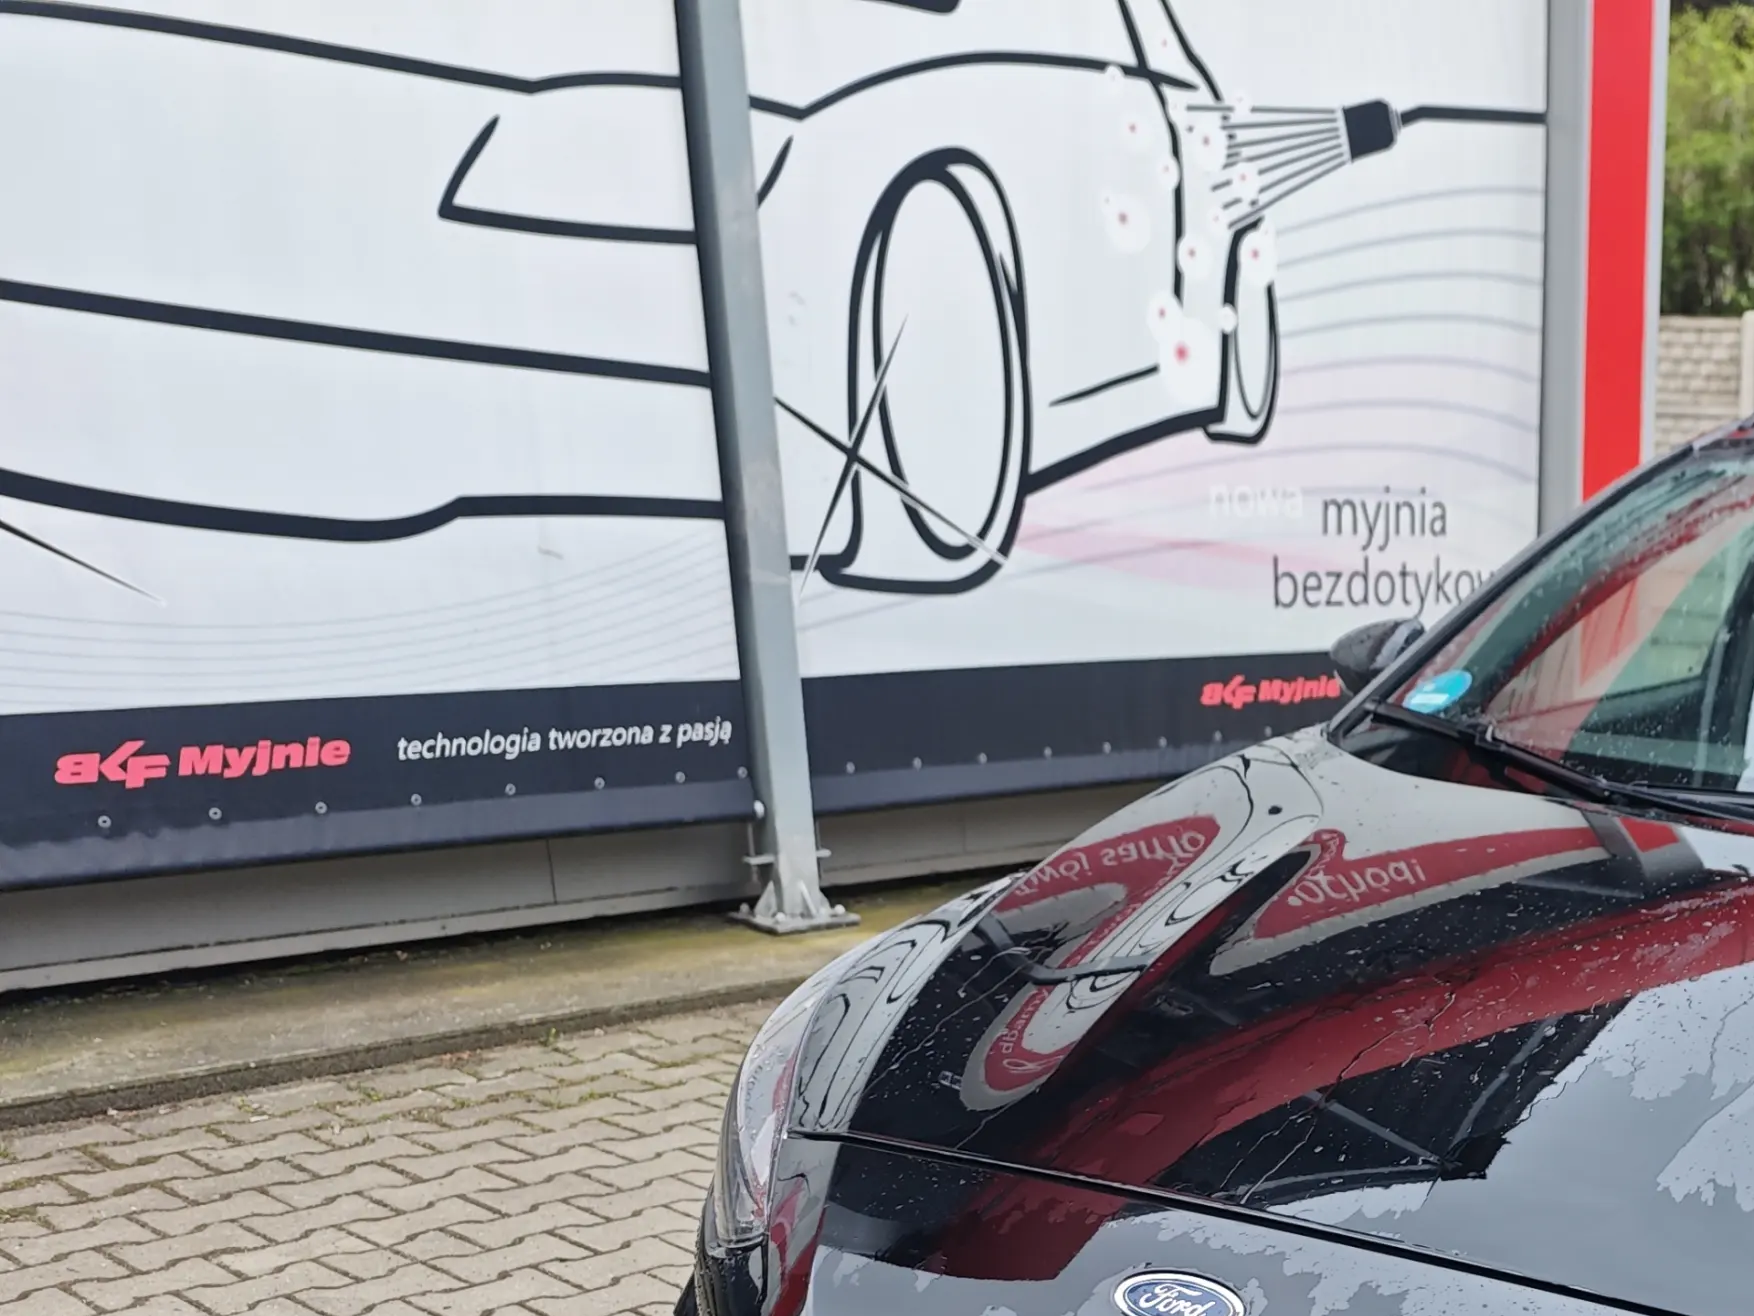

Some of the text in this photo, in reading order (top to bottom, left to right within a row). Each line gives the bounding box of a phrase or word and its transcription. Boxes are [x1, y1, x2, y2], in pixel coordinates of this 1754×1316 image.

[1321, 485, 1448, 552] myjnia
[1272, 554, 1495, 620] bezdotyko
[178, 736, 352, 779] Myjnie
[397, 715, 733, 761] technologia tworzona z pasją
